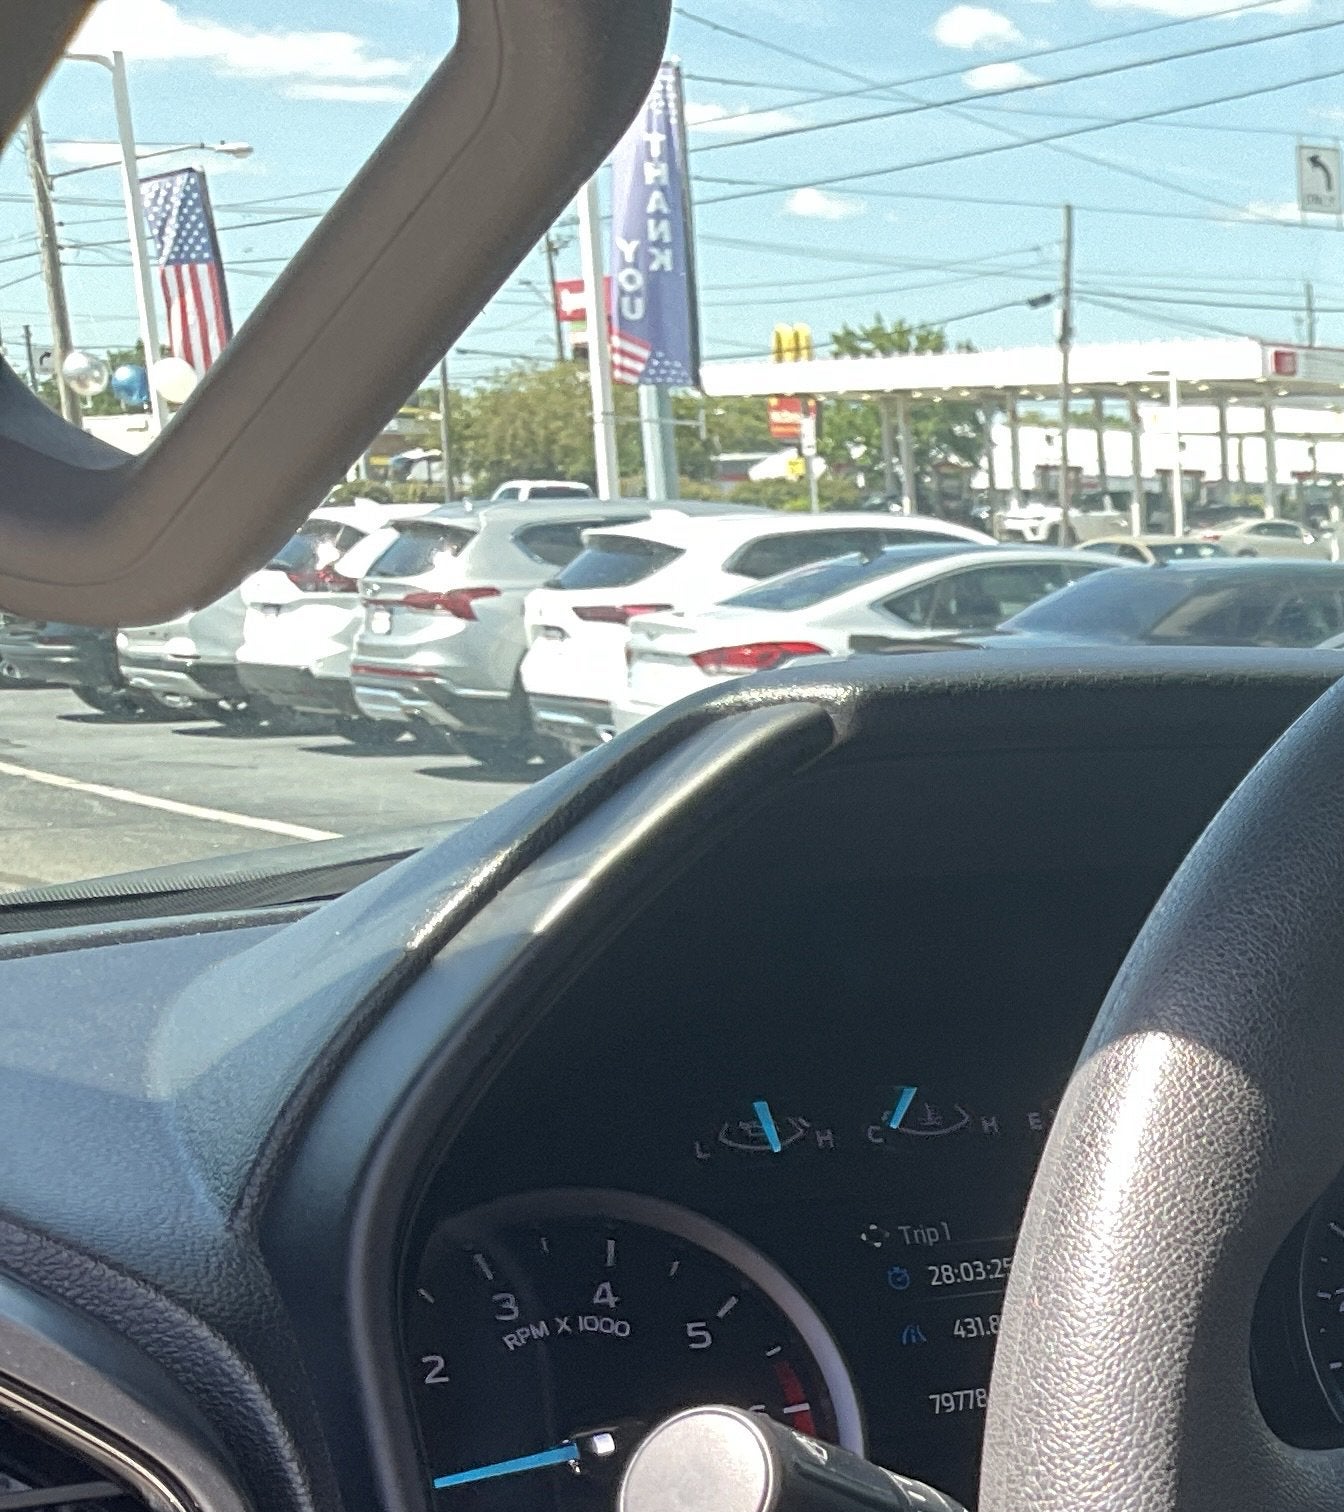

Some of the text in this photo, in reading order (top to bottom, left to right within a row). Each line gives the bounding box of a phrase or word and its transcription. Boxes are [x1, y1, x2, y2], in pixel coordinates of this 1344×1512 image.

[492, 1292, 520, 1321] 3
[593, 1280, 619, 1309] 4
[502, 1315, 631, 1351] RPM X 1000
[686, 1321, 713, 1350] 5
[420, 1354, 450, 1385] 2
